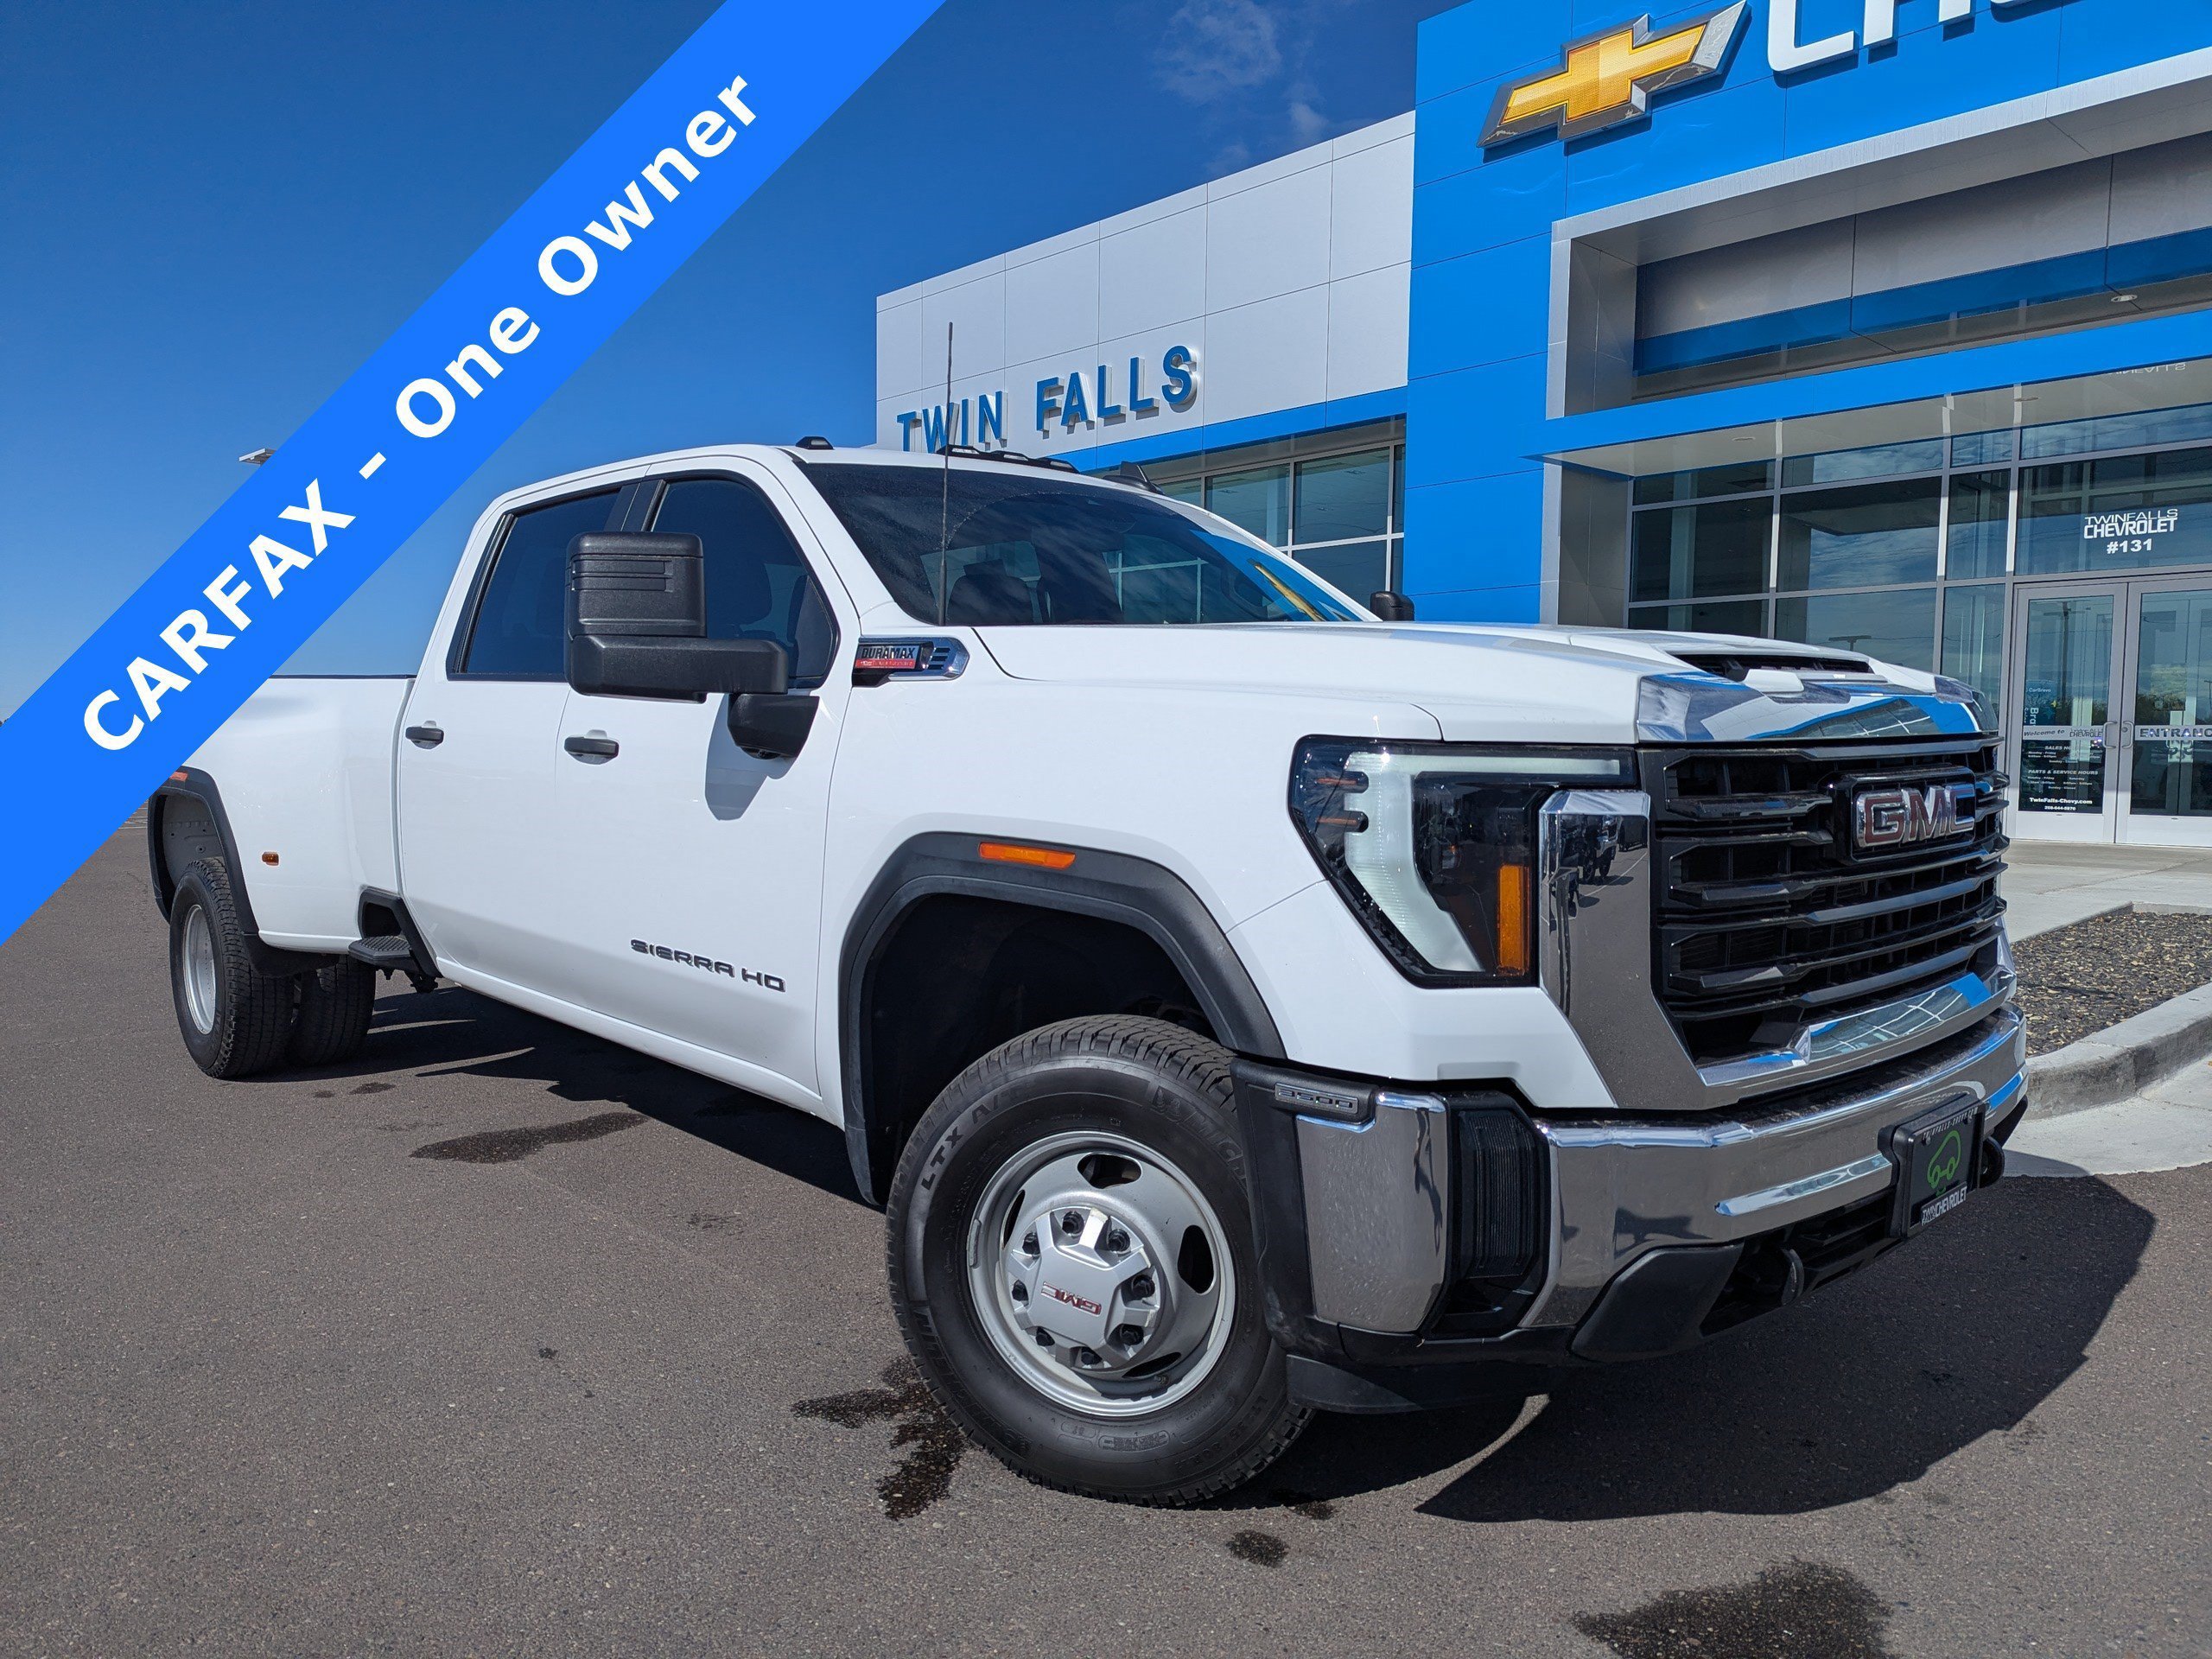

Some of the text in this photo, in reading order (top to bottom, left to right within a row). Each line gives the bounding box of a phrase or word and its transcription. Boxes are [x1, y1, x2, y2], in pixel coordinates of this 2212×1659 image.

[897, 346, 1196, 454] TWIN FALLS
[2084, 518, 2177, 538] CHEVROLET
[2085, 508, 2178, 525] TWINFALLS
[2107, 538, 2152, 554] #131
[861, 646, 916, 659] DURAMAX
[2029, 707, 2039, 726] Bra
[2140, 728, 2212, 738] ENTRANC
[1857, 785, 1976, 849] GMC
[631, 938, 786, 993] SIERRA HD
[921, 1126, 964, 1191] LTX
[1935, 1185, 1967, 1217] CHEVROLET
[1041, 1281, 1102, 1317] GMC
